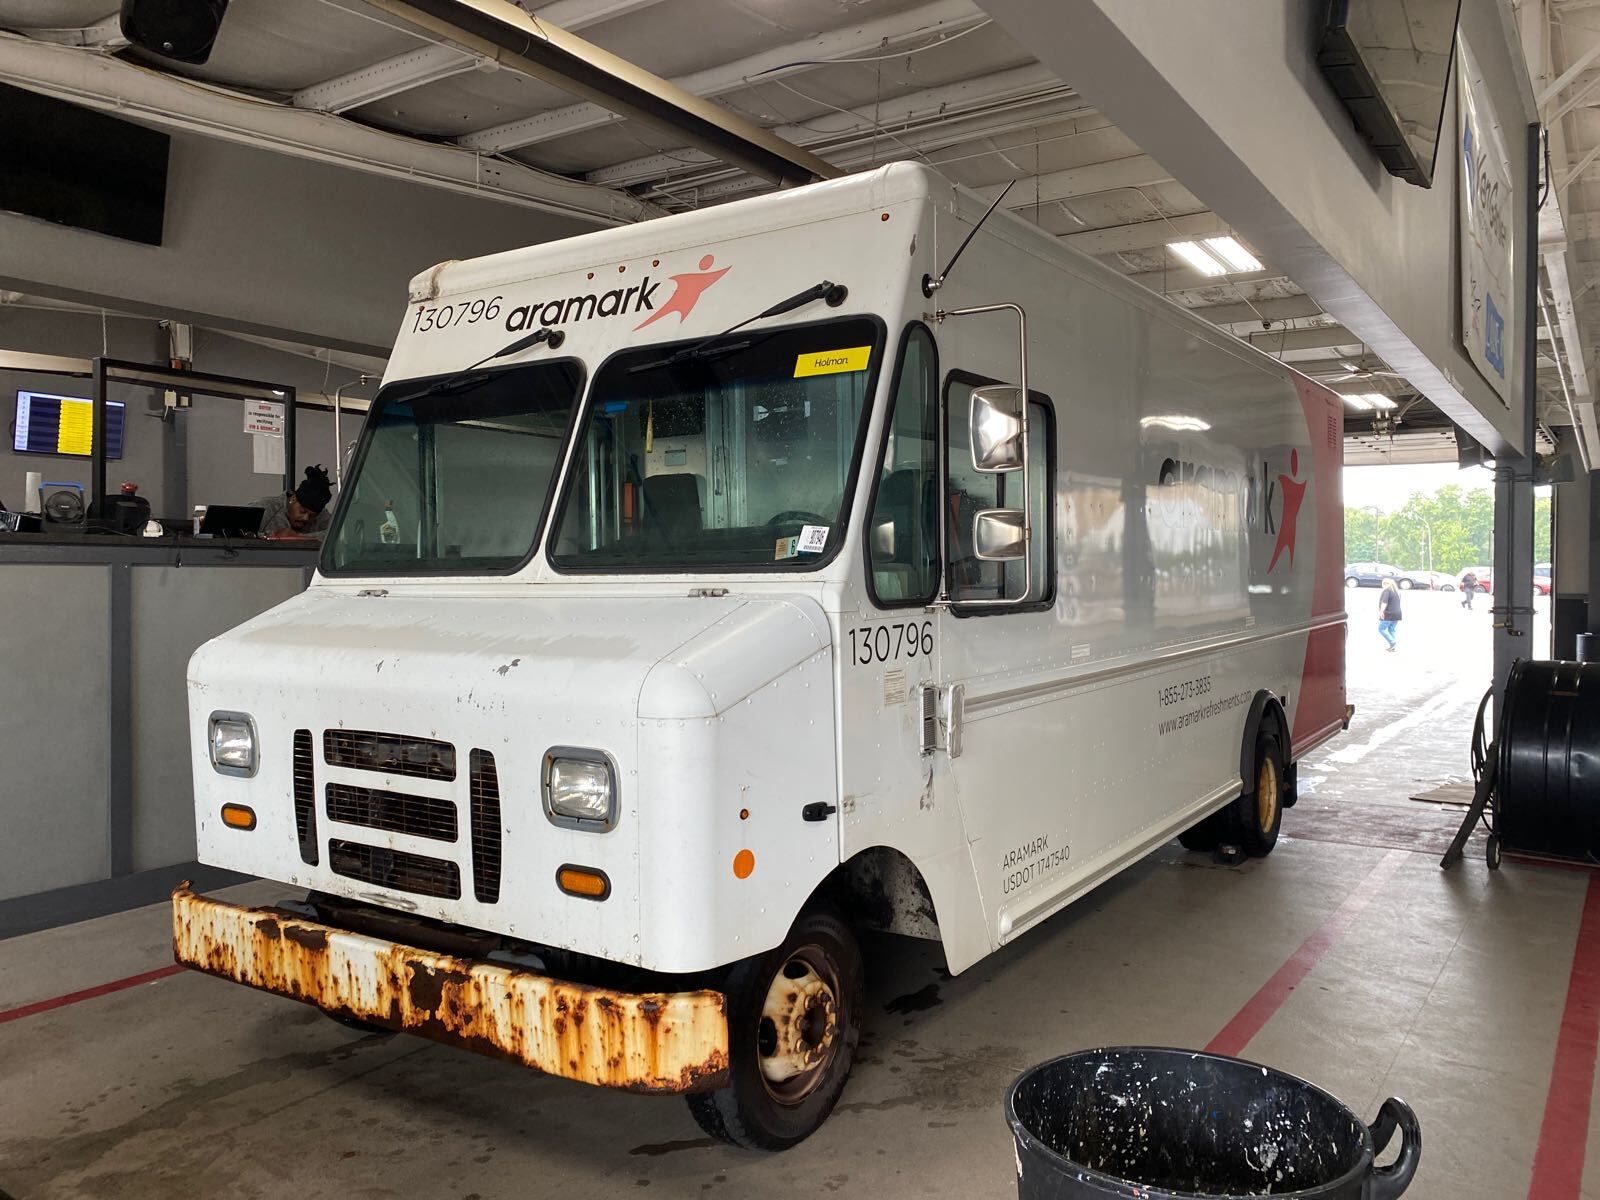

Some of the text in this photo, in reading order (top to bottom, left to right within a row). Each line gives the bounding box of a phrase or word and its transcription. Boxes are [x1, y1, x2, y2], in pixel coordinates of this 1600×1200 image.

[412, 276, 661, 334] 130796 aramark
[814, 357, 848, 368] Holman
[1158, 457, 1276, 536] aramak
[848, 621, 934, 666] 130796
[1158, 690, 1253, 736] www.aramarkrefreshments.com
[1159, 676, 1212, 708] 1-855-273-3835
[1003, 834, 1049, 871] ARAMARK
[1004, 845, 1070, 894] USDOT 1747540
